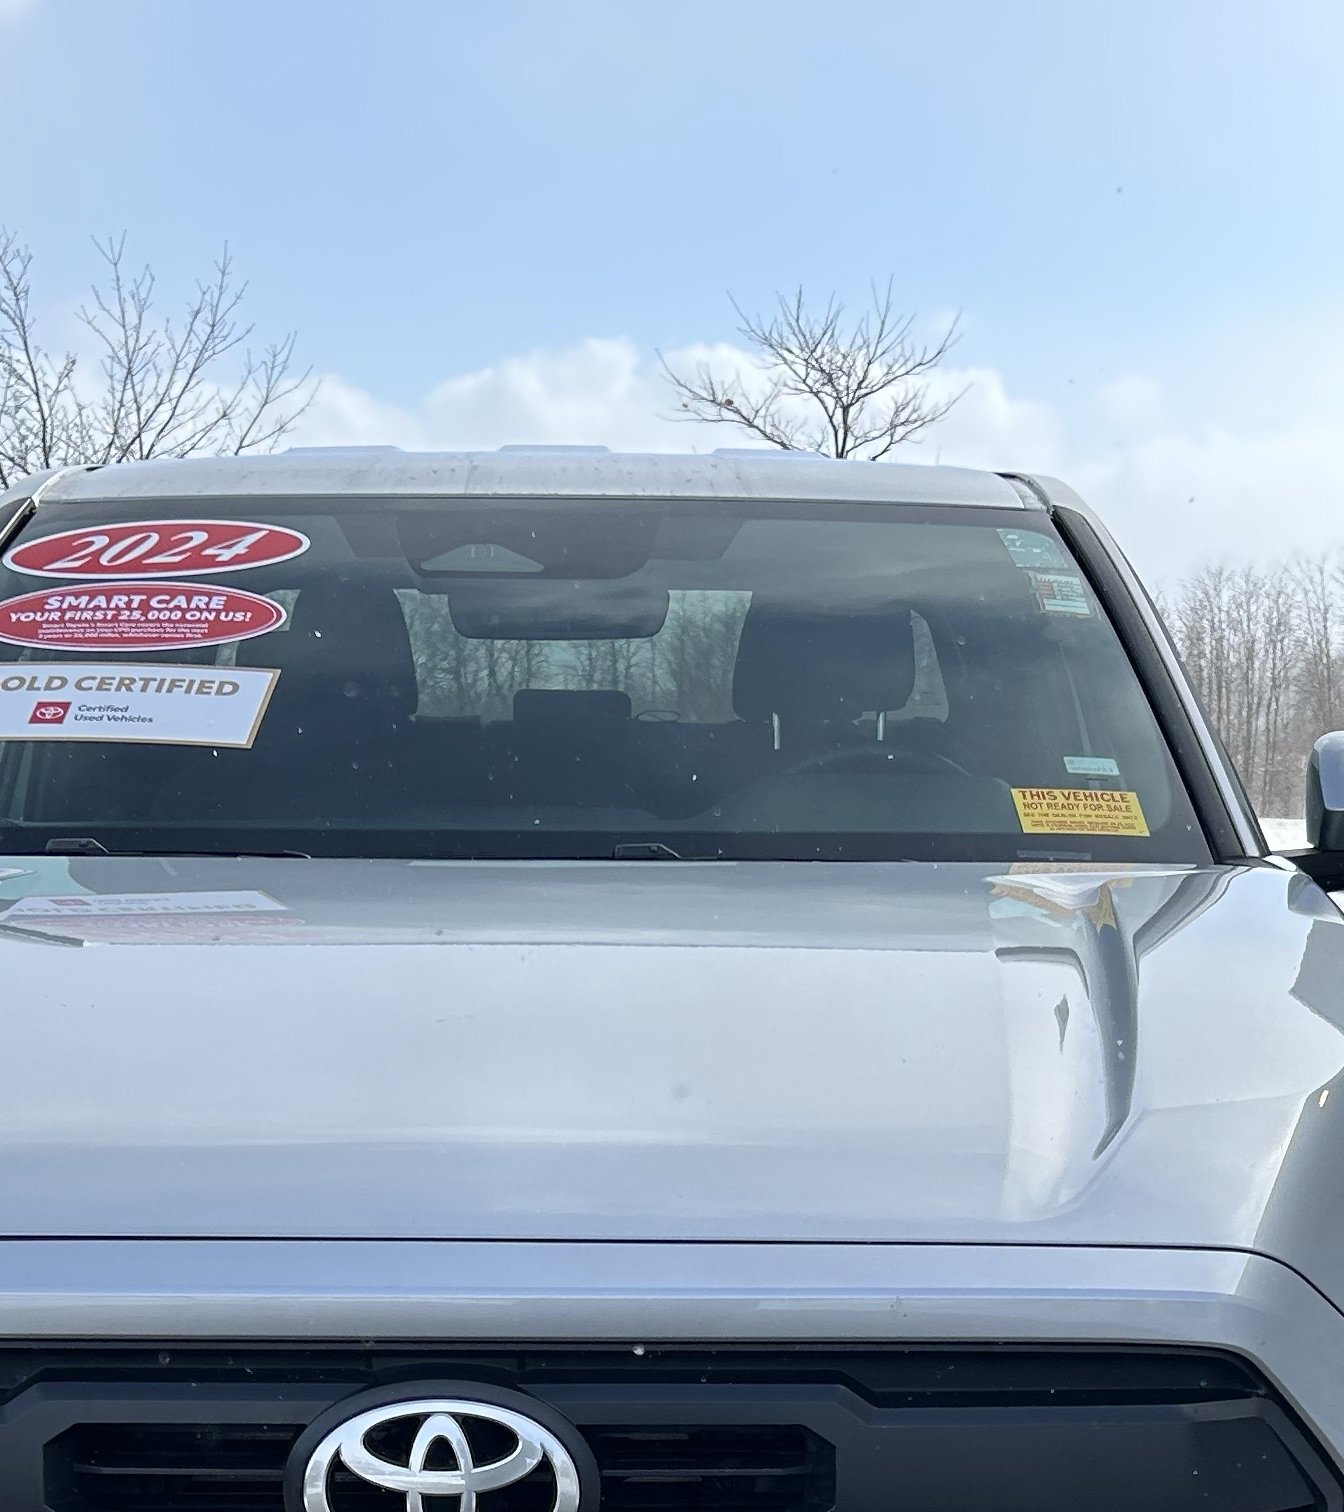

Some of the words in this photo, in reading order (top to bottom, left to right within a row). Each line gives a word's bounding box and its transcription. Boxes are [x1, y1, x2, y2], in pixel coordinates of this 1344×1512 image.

[43, 529, 270, 570] 2024
[43, 594, 147, 610] SMART
[149, 594, 228, 610] CARE
[9, 611, 59, 623] YOUR
[63, 610, 120, 621] FIRST
[119, 610, 182, 623] 25,000
[184, 611, 217, 621] ON
[219, 612, 253, 622] US!
[74, 676, 241, 697] CERTIFIED
[77, 704, 130, 713] Certified
[73, 714, 105, 723] Used
[106, 714, 155, 724] Vehicles
[1018, 789, 1058, 801] THIS
[1060, 790, 1131, 804] VEHICLE
[1022, 802, 1044, 811] NOT
[1046, 802, 1081, 812] READY
[1083, 803, 1104, 812] FOR
[1105, 804, 1133, 813] SALE
